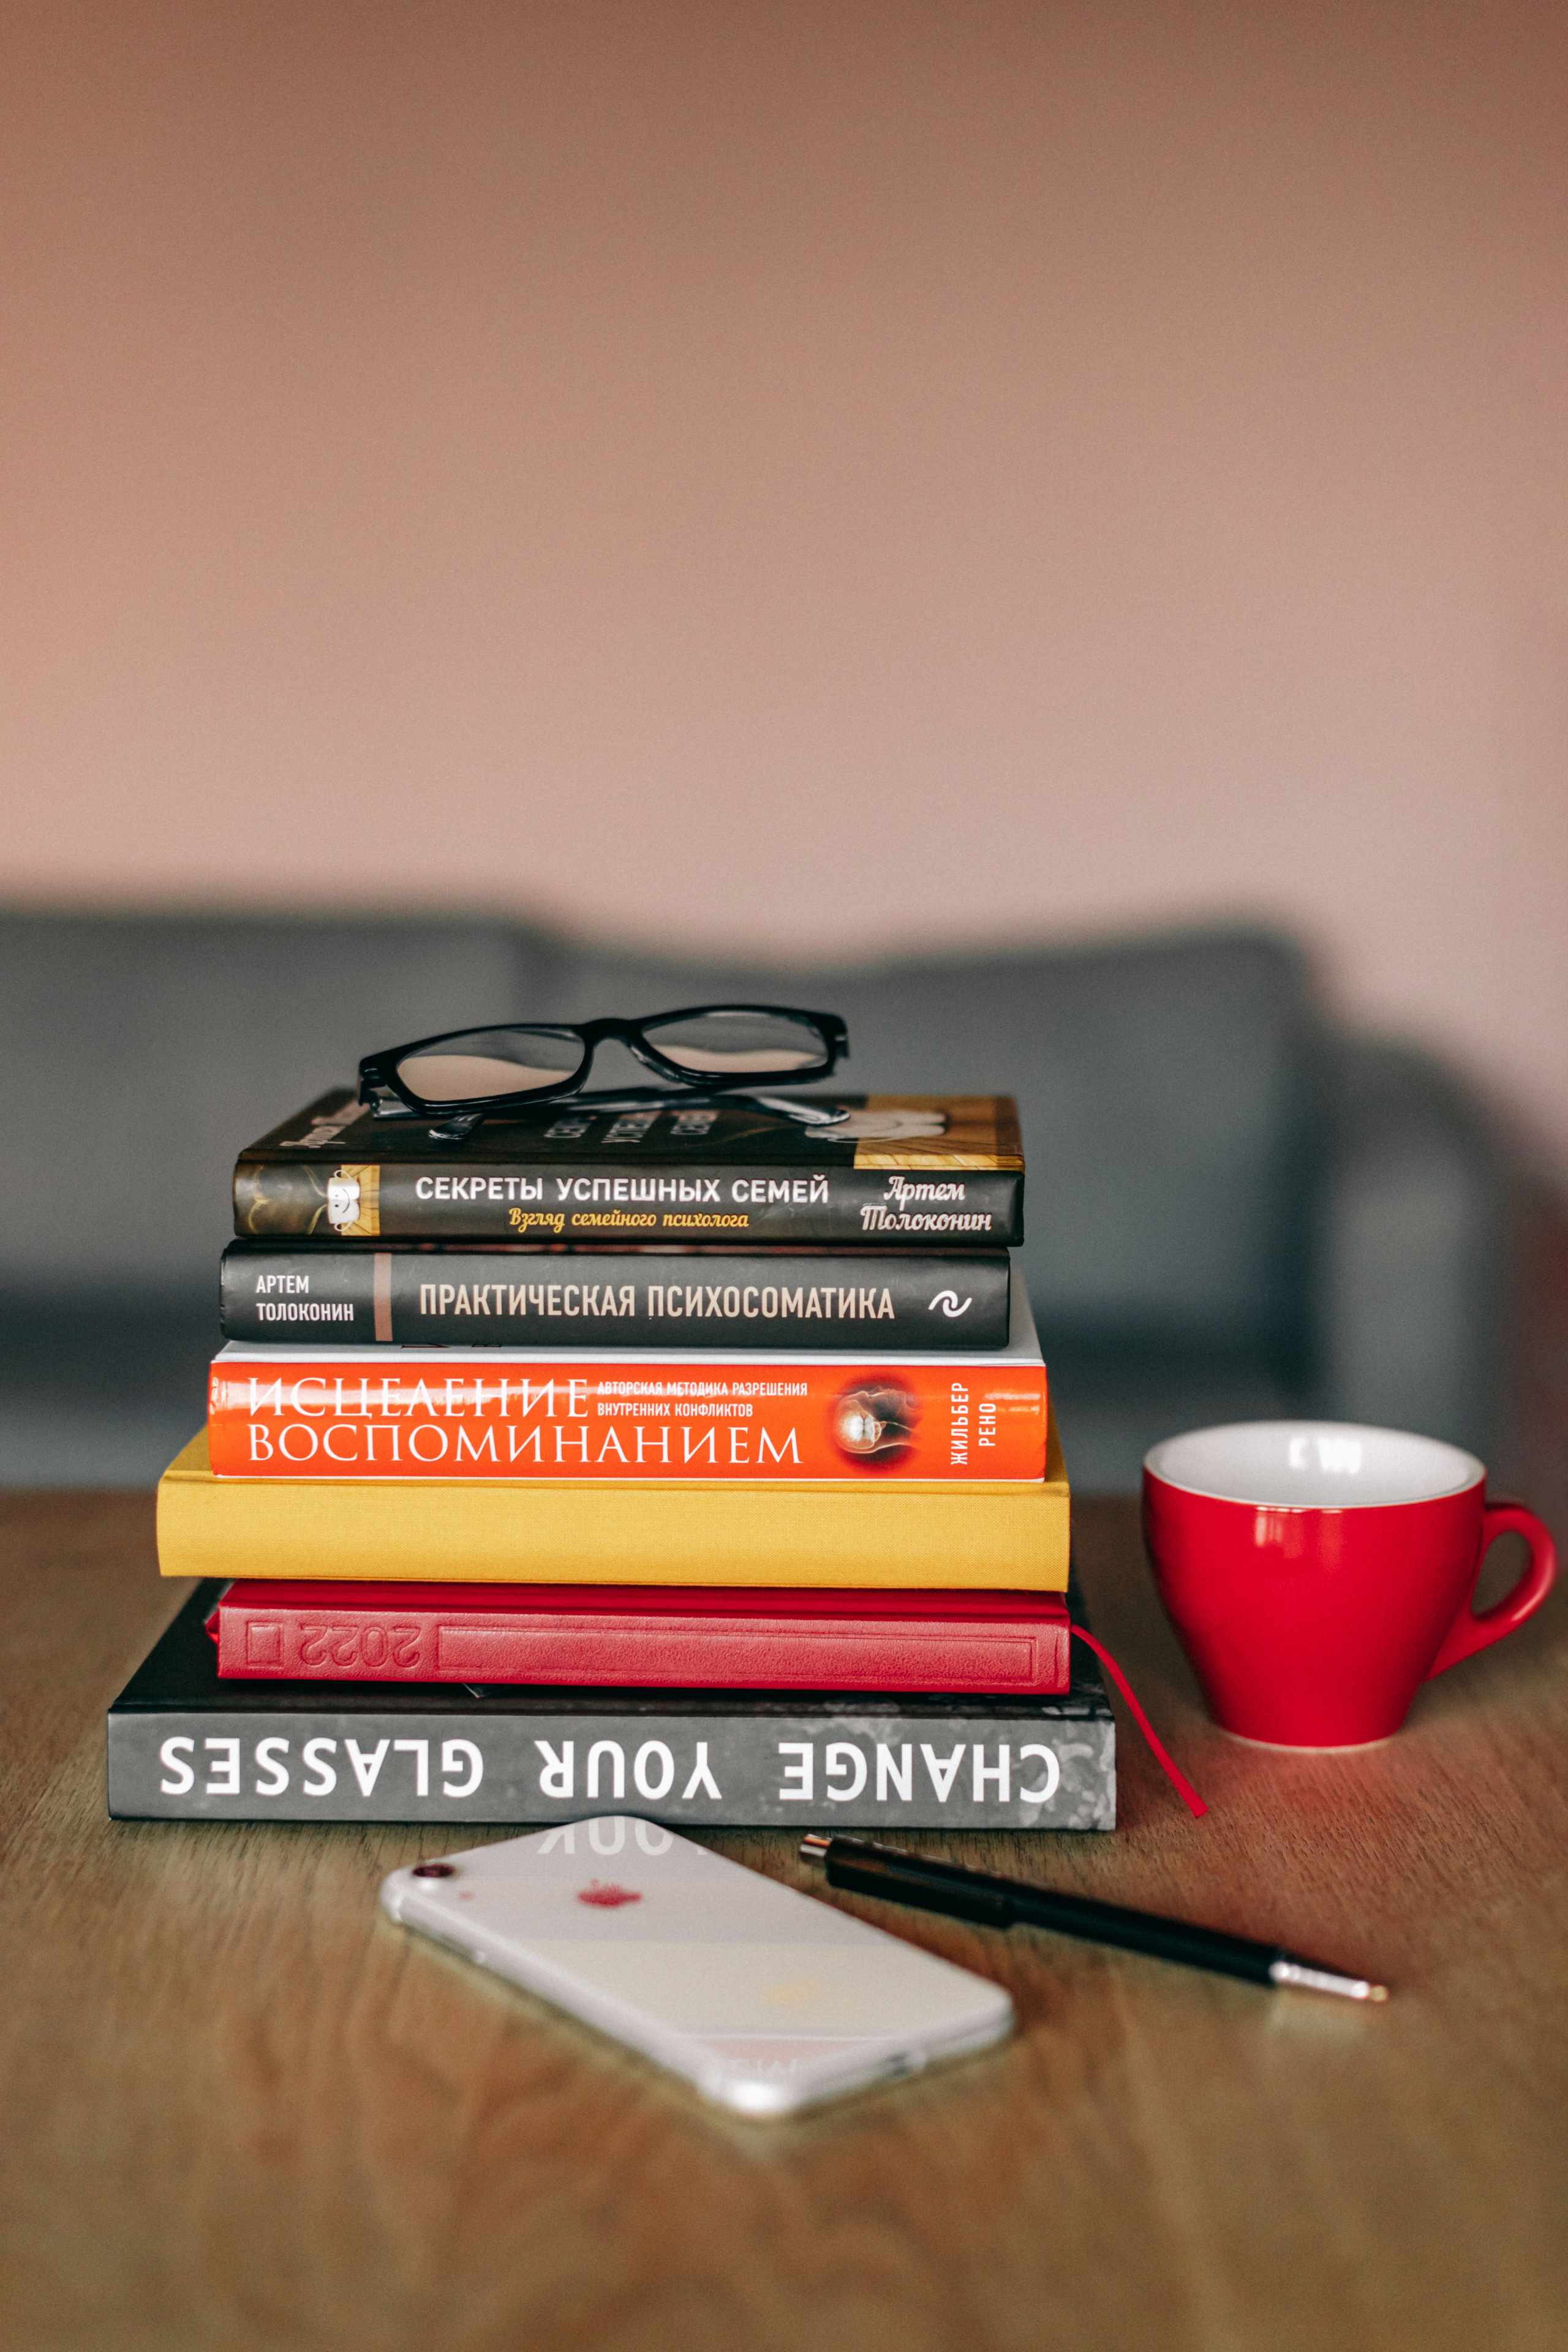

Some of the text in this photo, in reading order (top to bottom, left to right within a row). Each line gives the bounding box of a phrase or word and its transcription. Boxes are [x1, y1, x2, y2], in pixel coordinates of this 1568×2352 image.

[415, 1174, 829, 1204] СЕКРЕТЫ УСПЕШНЫХ СЕМЕЙ
[883, 1175, 965, 1211] Артем
[508, 1207, 749, 1234] Взгляд семейного психолога
[859, 1204, 992, 1231] Толоконин
[255, 1275, 309, 1294] АРТЕМ
[420, 1283, 895, 1319] ПРАКТИЧЕСКАЯ ПСИХОСОМАТИКА
[255, 1303, 354, 1321] ТОЛОКОНИН
[247, 1377, 589, 1420] ИСЦЕЛЕНИЕ
[597, 1381, 808, 1397] АВТОРСКАЯ МЕТОДИКА РАЗРЕШЕНИЯ
[597, 1402, 753, 1418] ВНУТРЕННИХ КОНФЛИКТОВ
[950, 1382, 969, 1465] ЖИЛЬБЕР
[978, 1403, 997, 1447] РЕНО
[247, 1423, 804, 1464] ВОСПОМИНАНИЕМ
[300, 1624, 423, 1668] 2022
[159, 1736, 1061, 1804] CHANGE YOUR GLASSES
